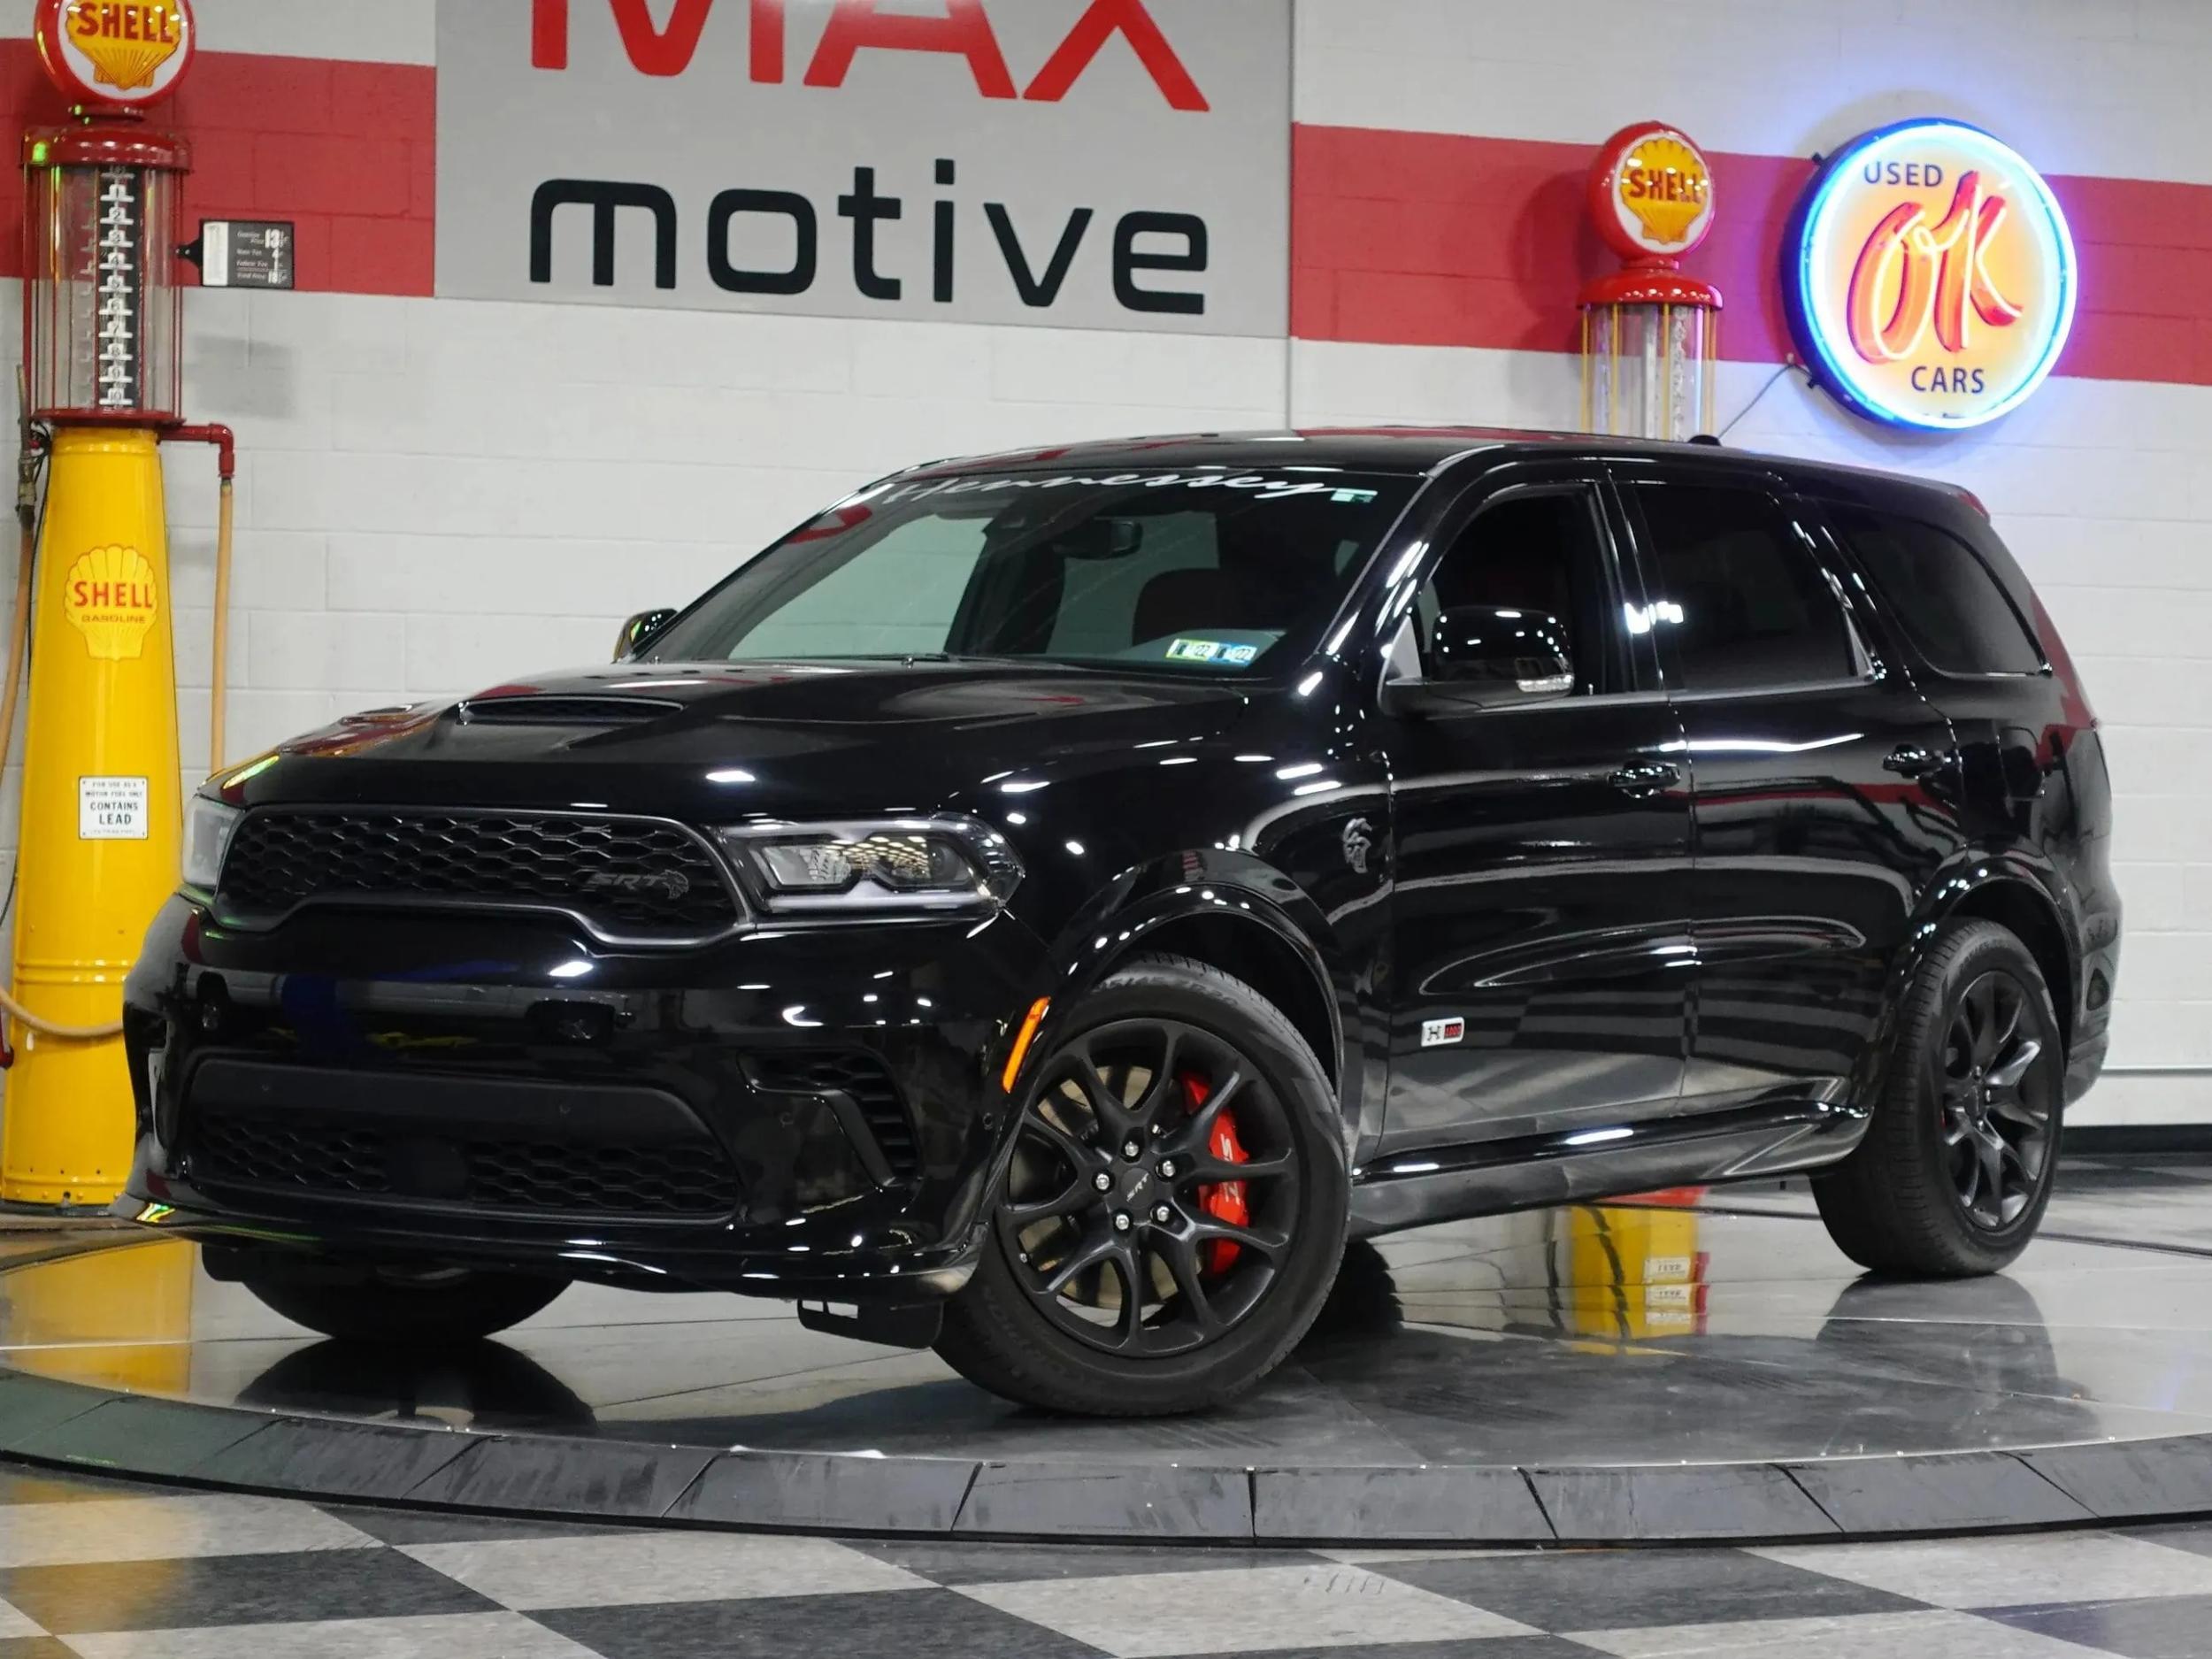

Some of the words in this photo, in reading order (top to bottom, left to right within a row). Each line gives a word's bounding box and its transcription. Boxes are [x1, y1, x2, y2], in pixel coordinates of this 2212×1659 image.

[76, 2, 174, 44] SHELL
[1628, 168, 1701, 204] SHELL
[1863, 162, 1944, 188] USED
[530, 157, 1209, 315] motive
[1847, 170, 2024, 365] OK
[1910, 365, 1985, 396] CARS
[883, 471, 1336, 504] Hennessey
[73, 580, 153, 610] SHELL
[81, 614, 146, 625] GASOLINE
[90, 802, 138, 810] CONTAINS
[99, 813, 132, 826] LEAD
[587, 872, 667, 891] SRT
